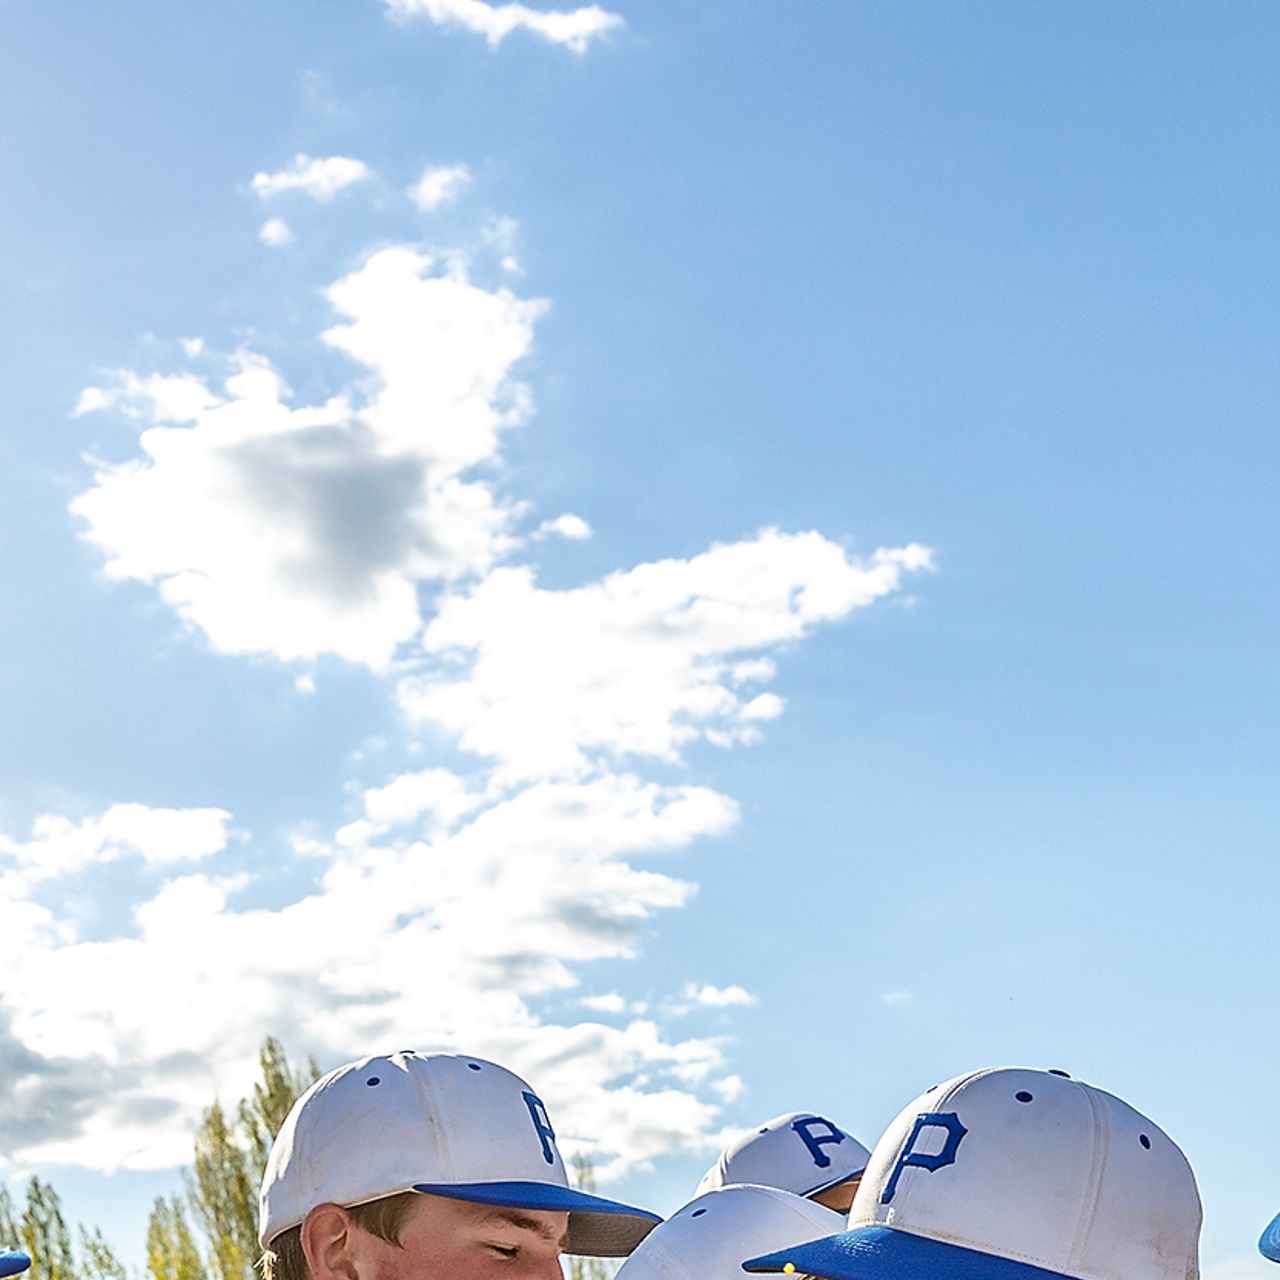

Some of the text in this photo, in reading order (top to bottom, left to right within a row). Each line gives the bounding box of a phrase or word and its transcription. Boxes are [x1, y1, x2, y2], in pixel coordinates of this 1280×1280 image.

[521, 1090, 556, 1165] P
[791, 1116, 846, 1168] P
[878, 1112, 969, 1204] P
